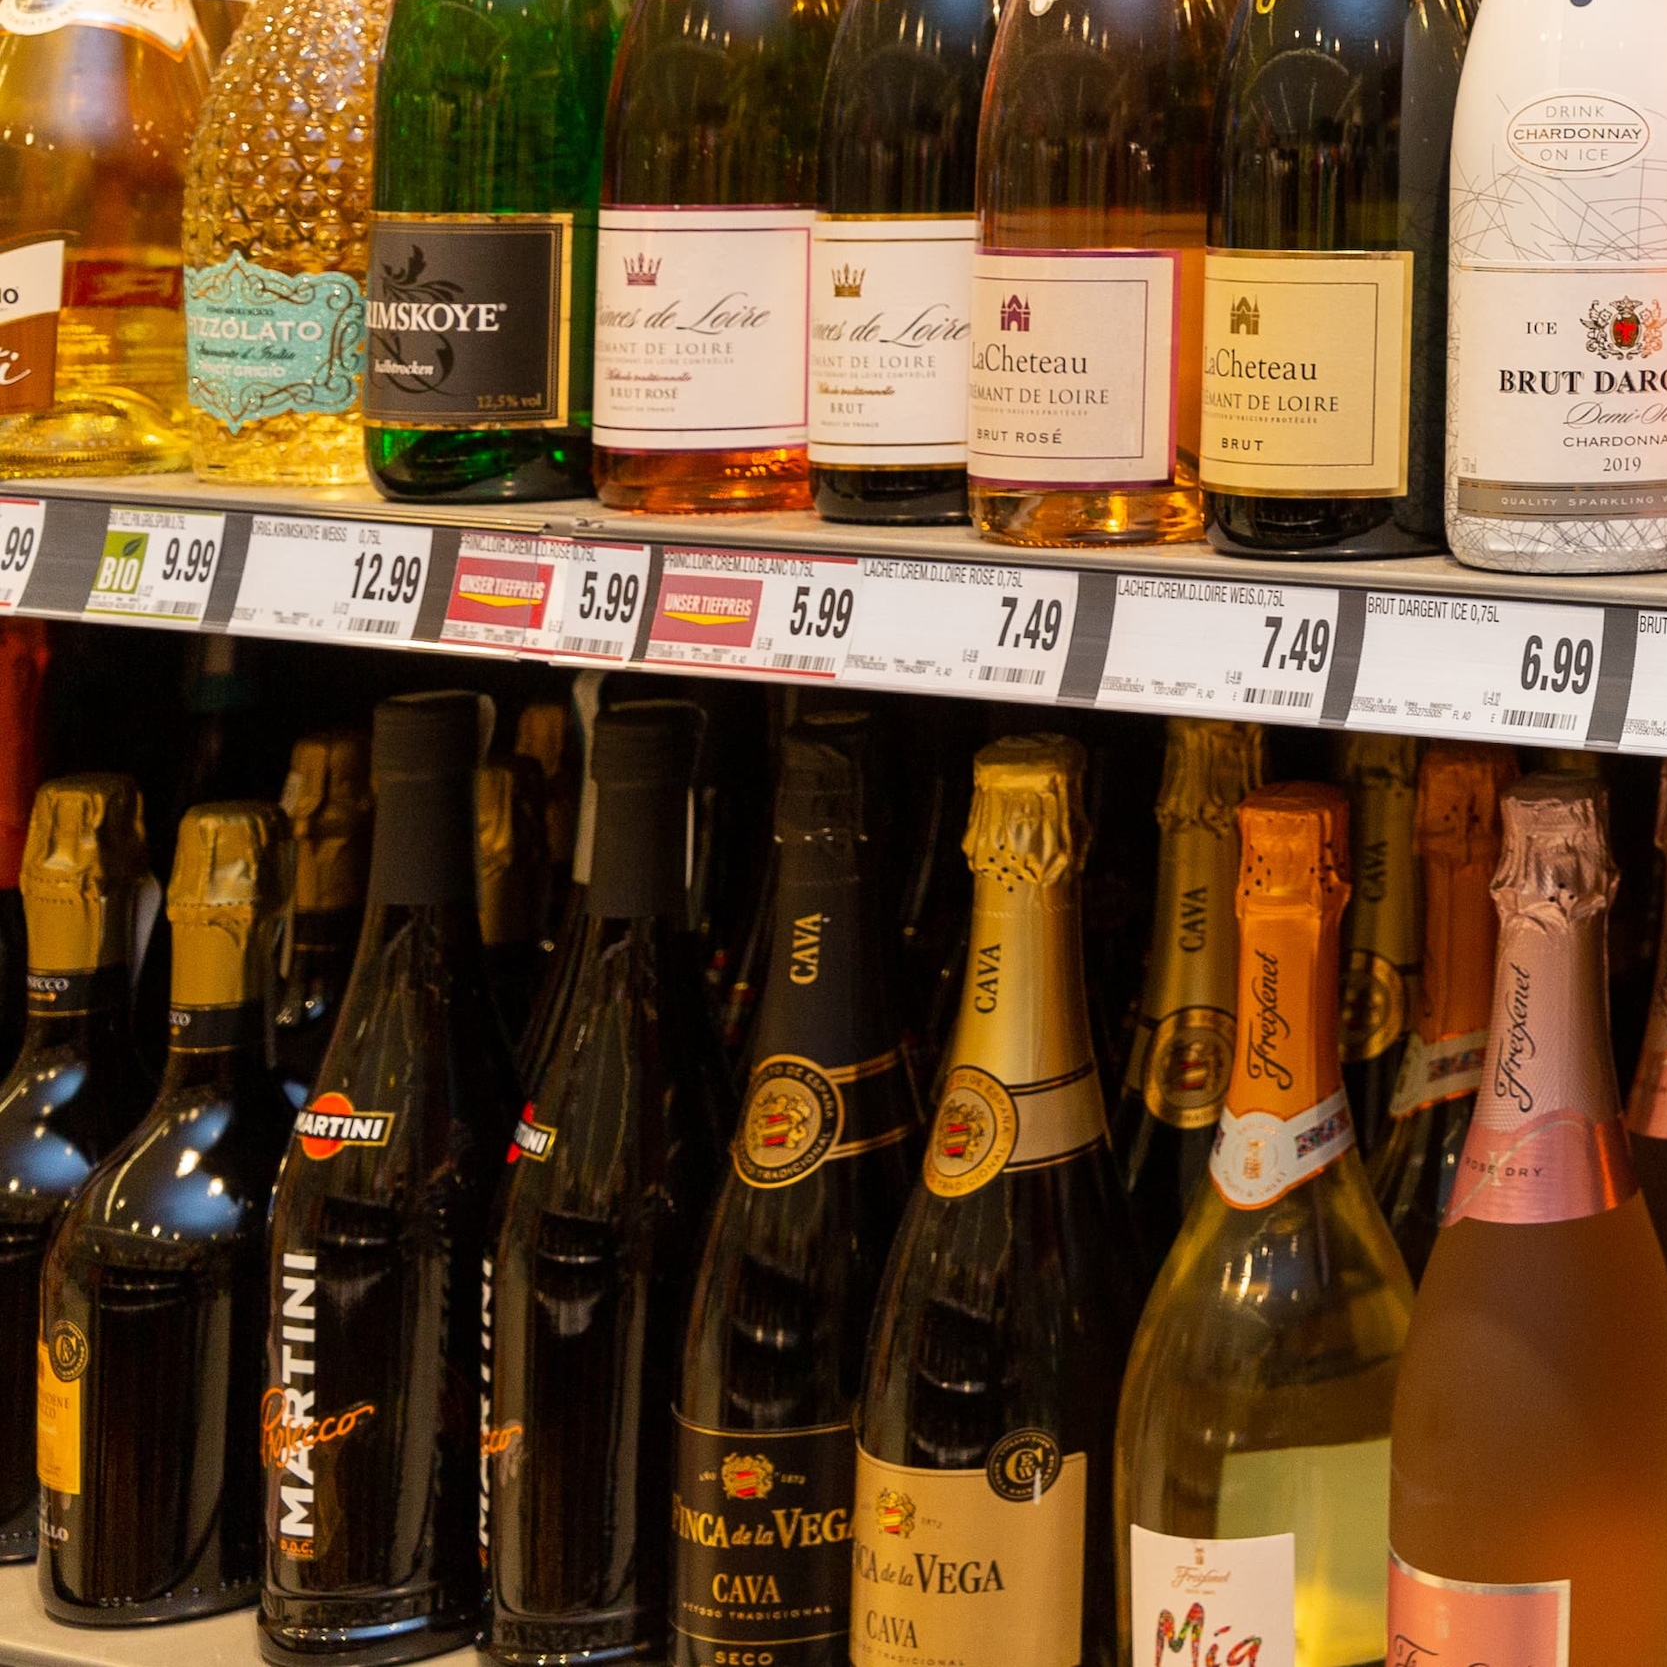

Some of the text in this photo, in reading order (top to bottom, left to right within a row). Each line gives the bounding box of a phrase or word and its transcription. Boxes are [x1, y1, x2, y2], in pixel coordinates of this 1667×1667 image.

[1545, 104, 1605, 120] DRINK
[1513, 126, 1643, 142] CHARDONNAY
[1540, 147, 1610, 162] ON ICE
[1526, 321, 1558, 335] ICE
[970, 341, 1088, 376] LaCheteau
[1203, 346, 1318, 381] LaCheteau
[1498, 368, 1585, 395] BRUT
[1221, 438, 1264, 453] BRUT
[1602, 456, 1642, 473] 2019
[98, 554, 139, 592] BIO
[162, 537, 216, 584] 9.99
[350, 550, 422, 605] 12.99
[578, 570, 640, 624] 5.99
[663, 592, 752, 619] UNSER TIEFPREIS
[789, 584, 854, 639] 5.99
[996, 596, 1063, 651] 7.49
[1260, 615, 1330, 674] 7.49
[1519, 634, 1595, 695] 6.99
[788, 910, 823, 987] CAVA
[973, 941, 1003, 1016] CAVA
[1246, 950, 1294, 1093] Freixenet
[1494, 963, 1533, 1115] Freixenet
[280, 1253, 317, 1539] MARTINI
[712, 1572, 783, 1606] CAVA
[913, 1551, 1007, 1595] VEGA
[714, 1650, 775, 1667] SECO
